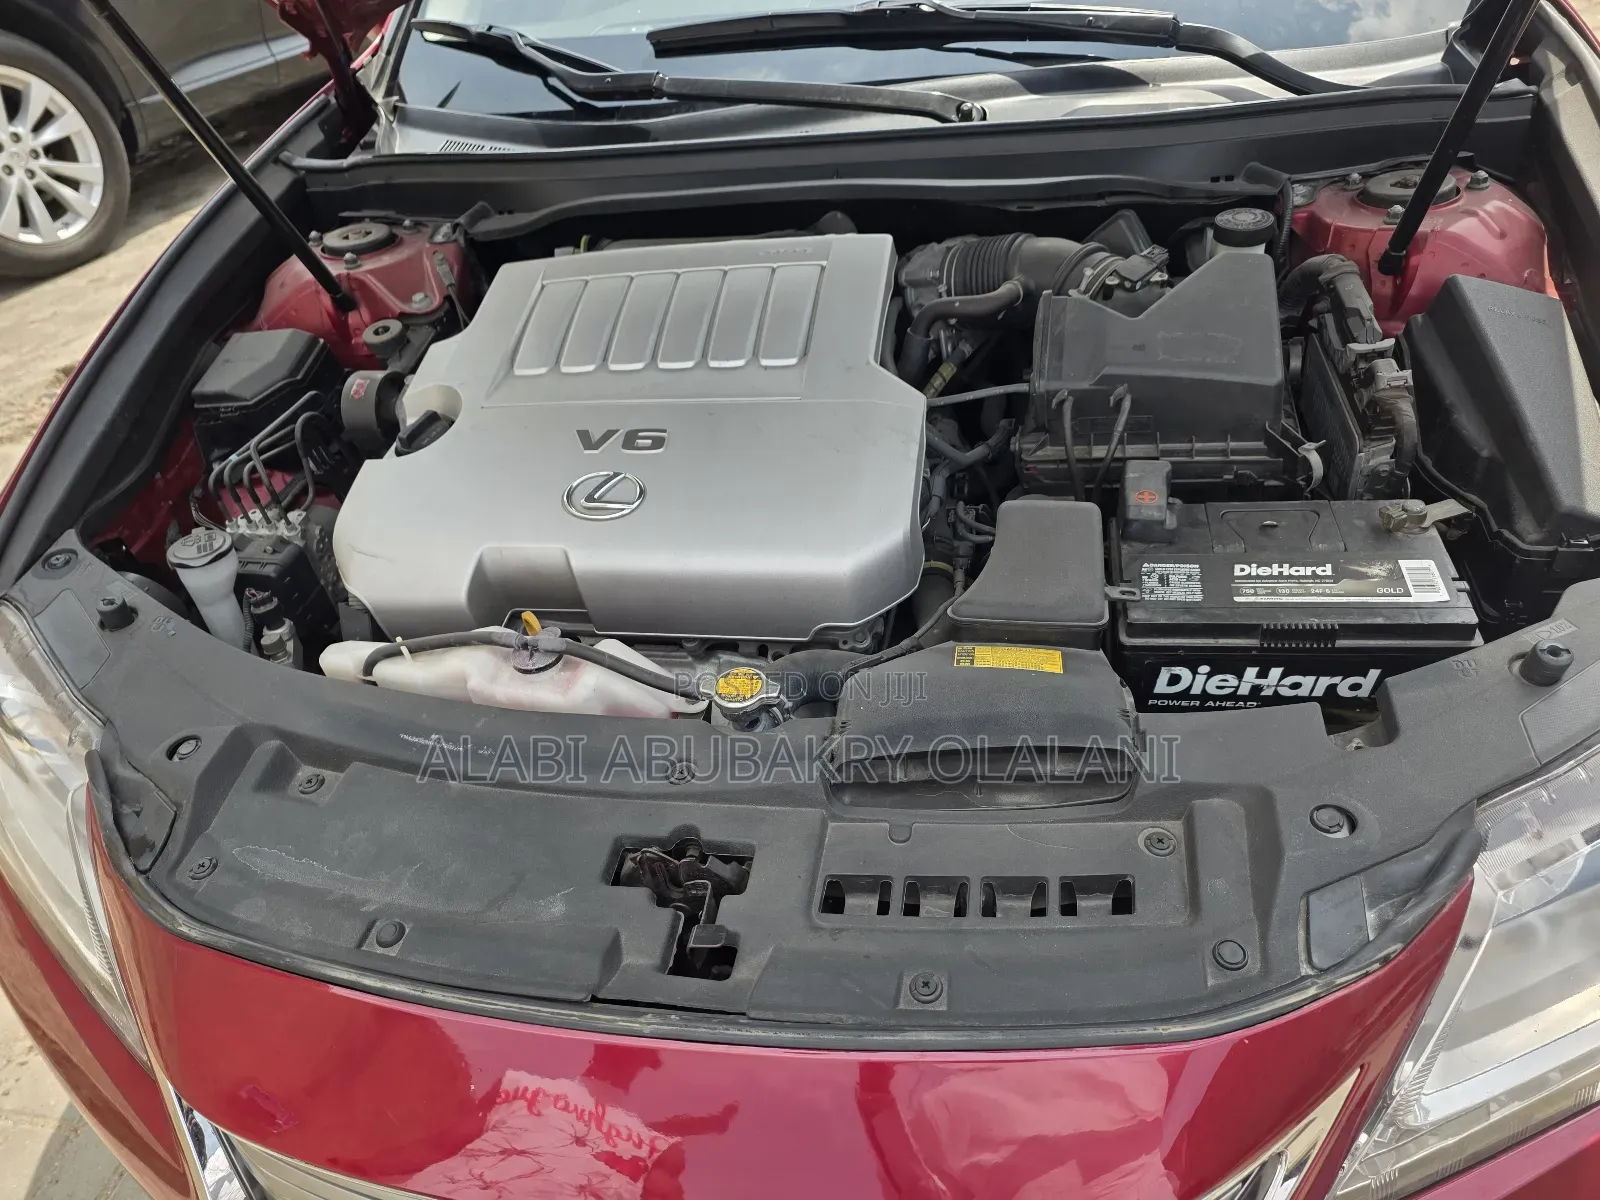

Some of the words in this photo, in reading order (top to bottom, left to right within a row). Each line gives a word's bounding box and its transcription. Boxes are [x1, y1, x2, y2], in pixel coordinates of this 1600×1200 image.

[574, 428, 668, 454] V6
[1233, 563, 1333, 577] DieHard
[1153, 664, 1382, 698] DieHard
[1148, 699, 1201, 707] POWER
[1205, 700, 1258, 708] AHEAD
